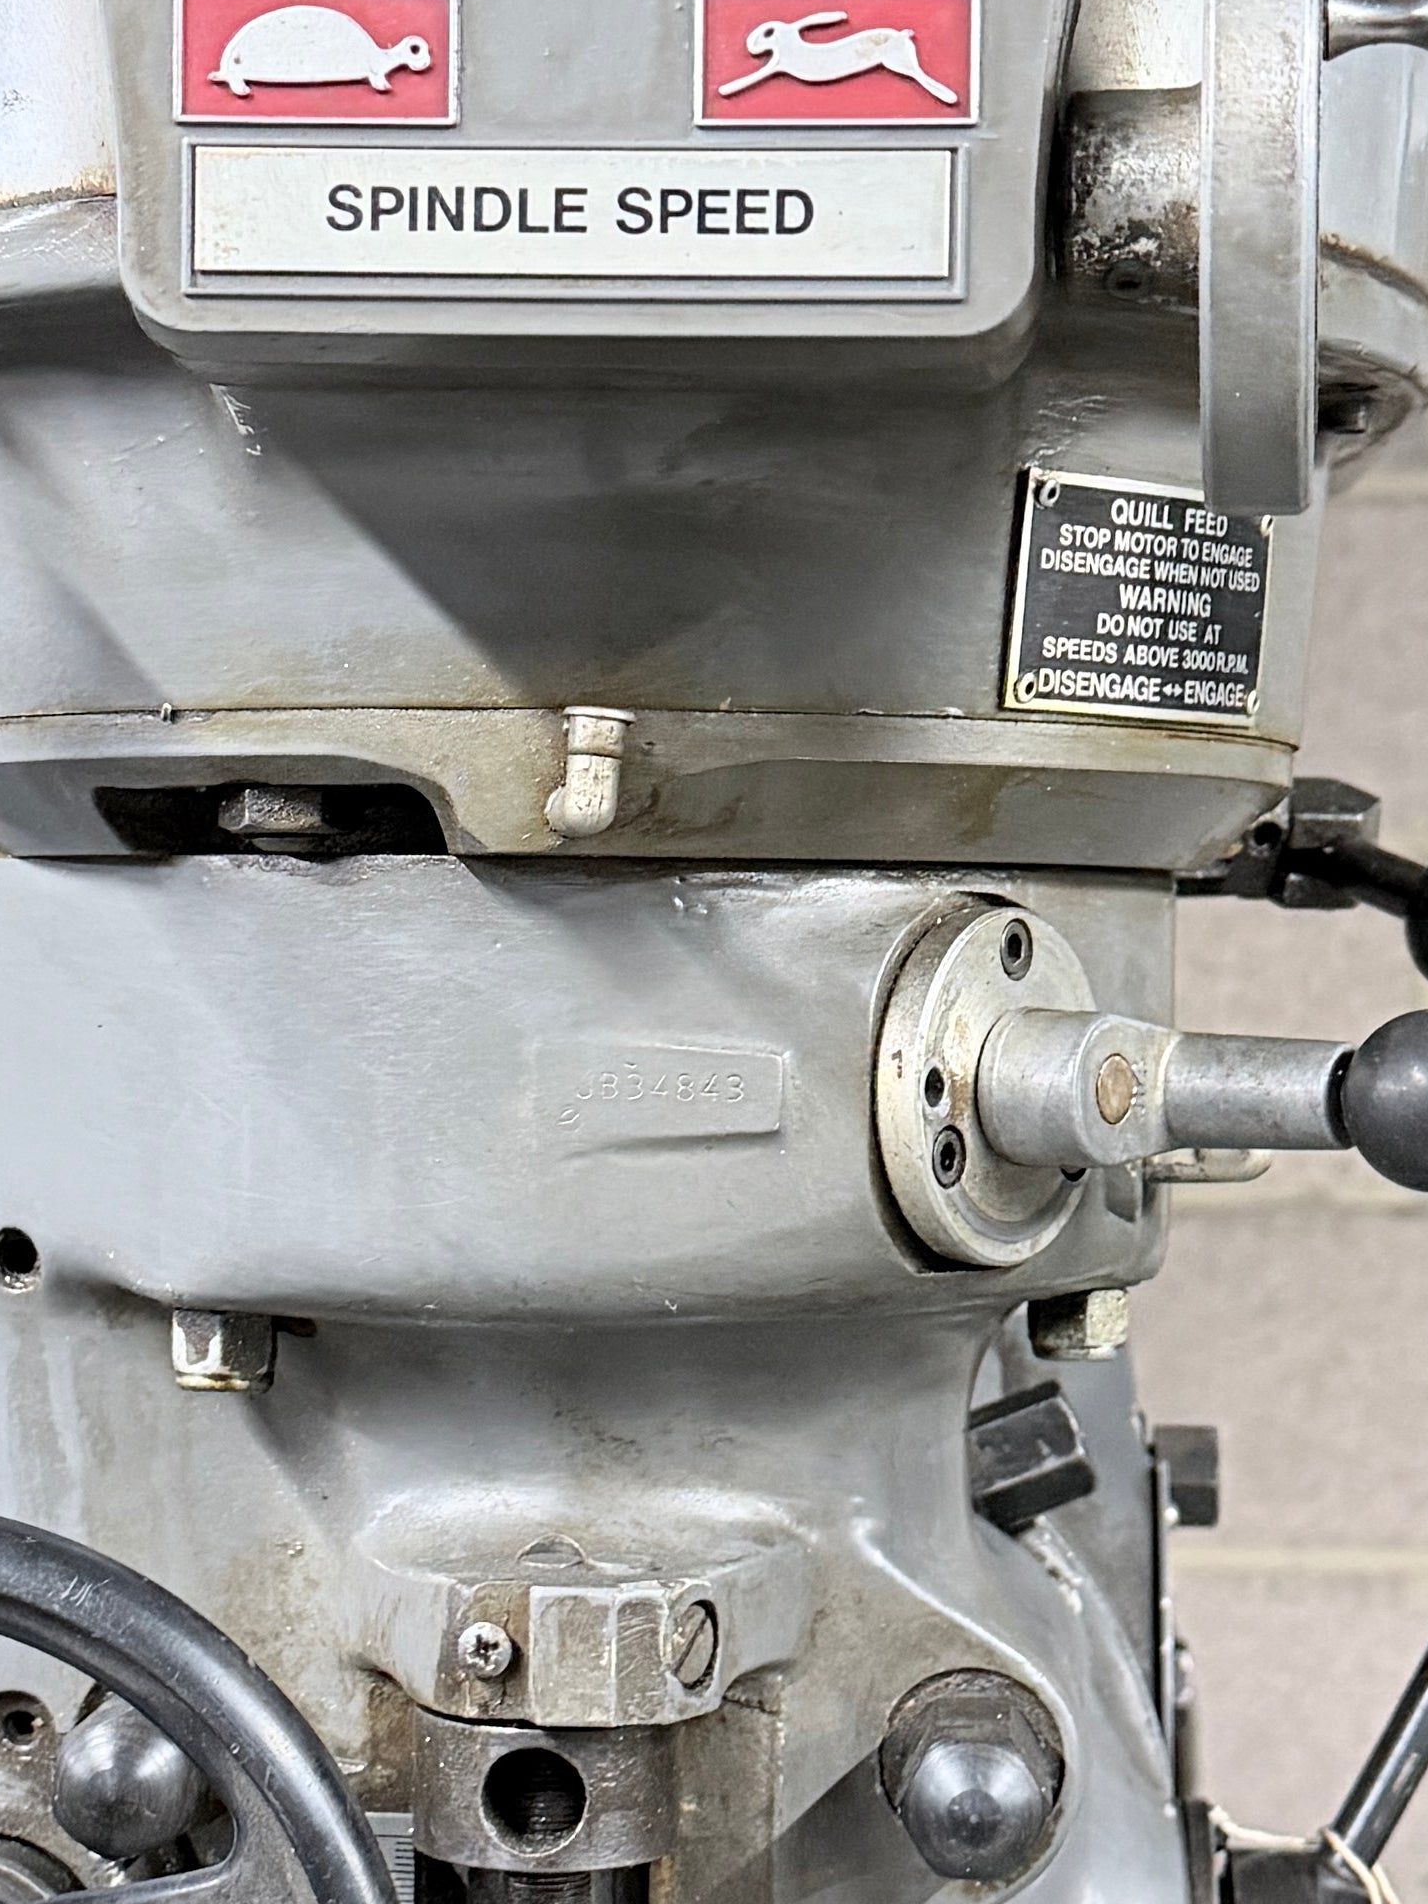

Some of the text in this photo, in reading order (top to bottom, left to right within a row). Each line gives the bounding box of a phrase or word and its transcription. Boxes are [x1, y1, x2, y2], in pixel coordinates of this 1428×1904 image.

[326, 183, 815, 235] SPINDLE SPEED
[1110, 498, 1228, 538] QUILL FEED
[1059, 524, 1253, 568] STOP MOTOR TO ENGAGE
[1040, 548, 1260, 593] DISENGAGE WHEN NOT USED
[1119, 584, 1212, 618] WARNING
[1096, 612, 1222, 645] DO NOT USE AT
[1042, 636, 1118, 664] SPEEDS
[1123, 644, 1179, 669] ABOVE
[1038, 668, 1246, 708] DISENGAGE ENGAGE
